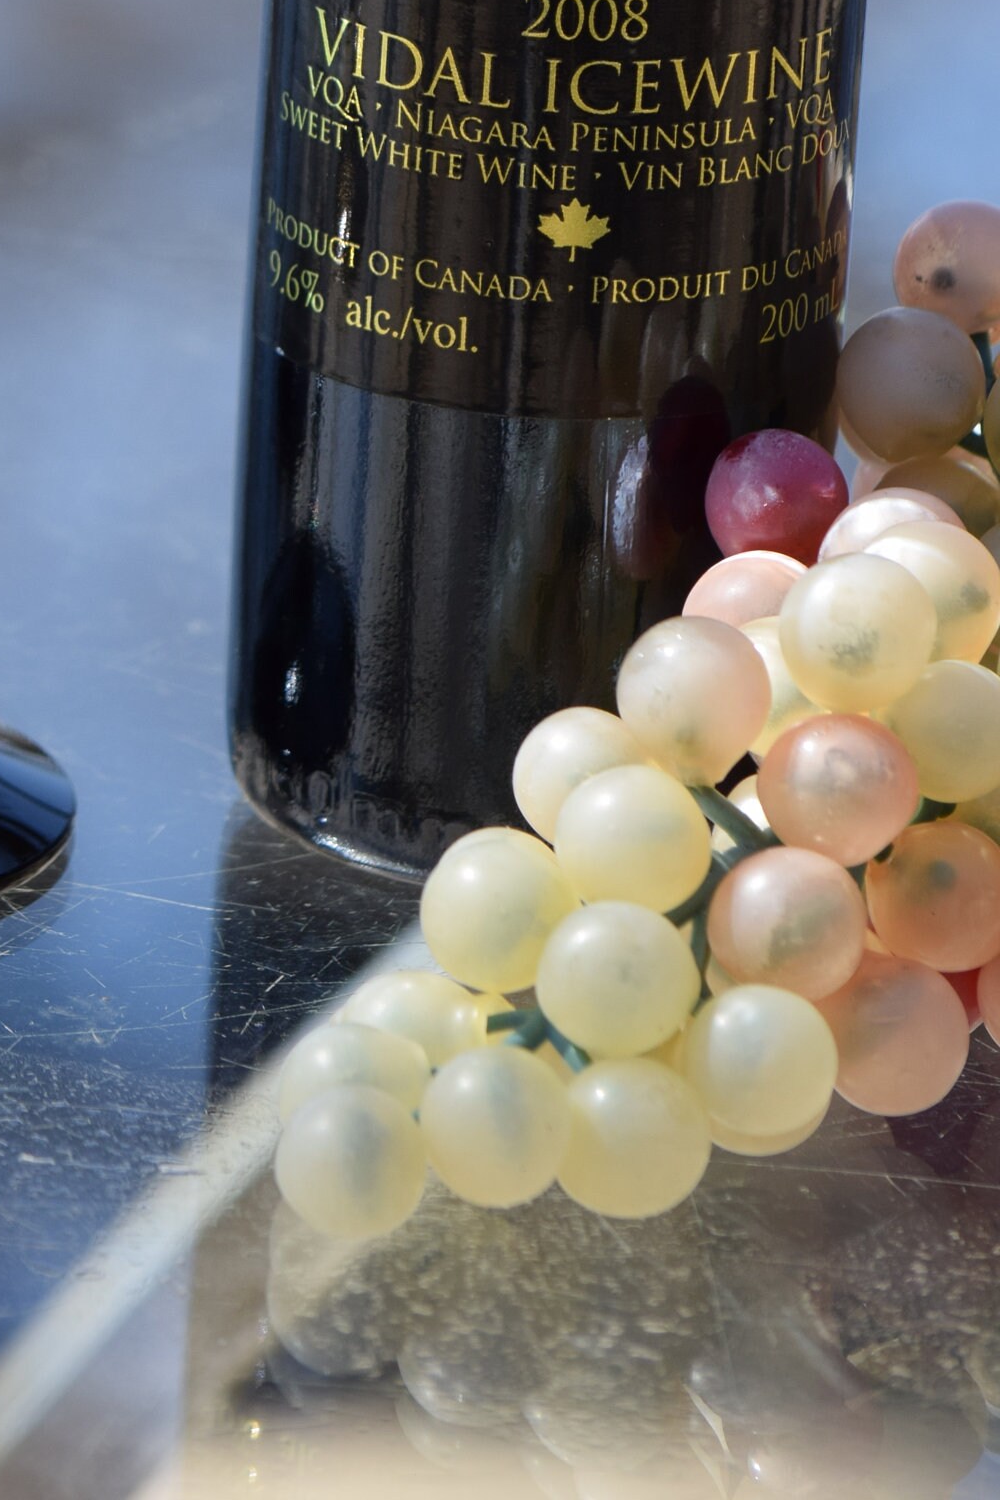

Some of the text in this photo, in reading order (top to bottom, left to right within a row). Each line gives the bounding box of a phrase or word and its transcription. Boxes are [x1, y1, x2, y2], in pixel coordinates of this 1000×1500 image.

[308, 65, 835, 152] VQA NIAGARA PENINSULA VQA
[316, 6, 832, 115] VIDAL ICEWINE
[280, 92, 347, 150] SWEET
[357, 126, 462, 181] WHITE
[477, 153, 576, 191] WINE
[618, 161, 683, 191] VIN
[699, 145, 793, 188] BLANC
[267, 197, 359, 268] PRODUCT
[369, 250, 404, 280] OF
[415, 259, 552, 302] CANADA
[591, 270, 731, 304] PRODUIT
[741, 260, 777, 292] DU
[269, 250, 478, 353] 9.6% alc./vol.
[759, 293, 808, 344] 200
